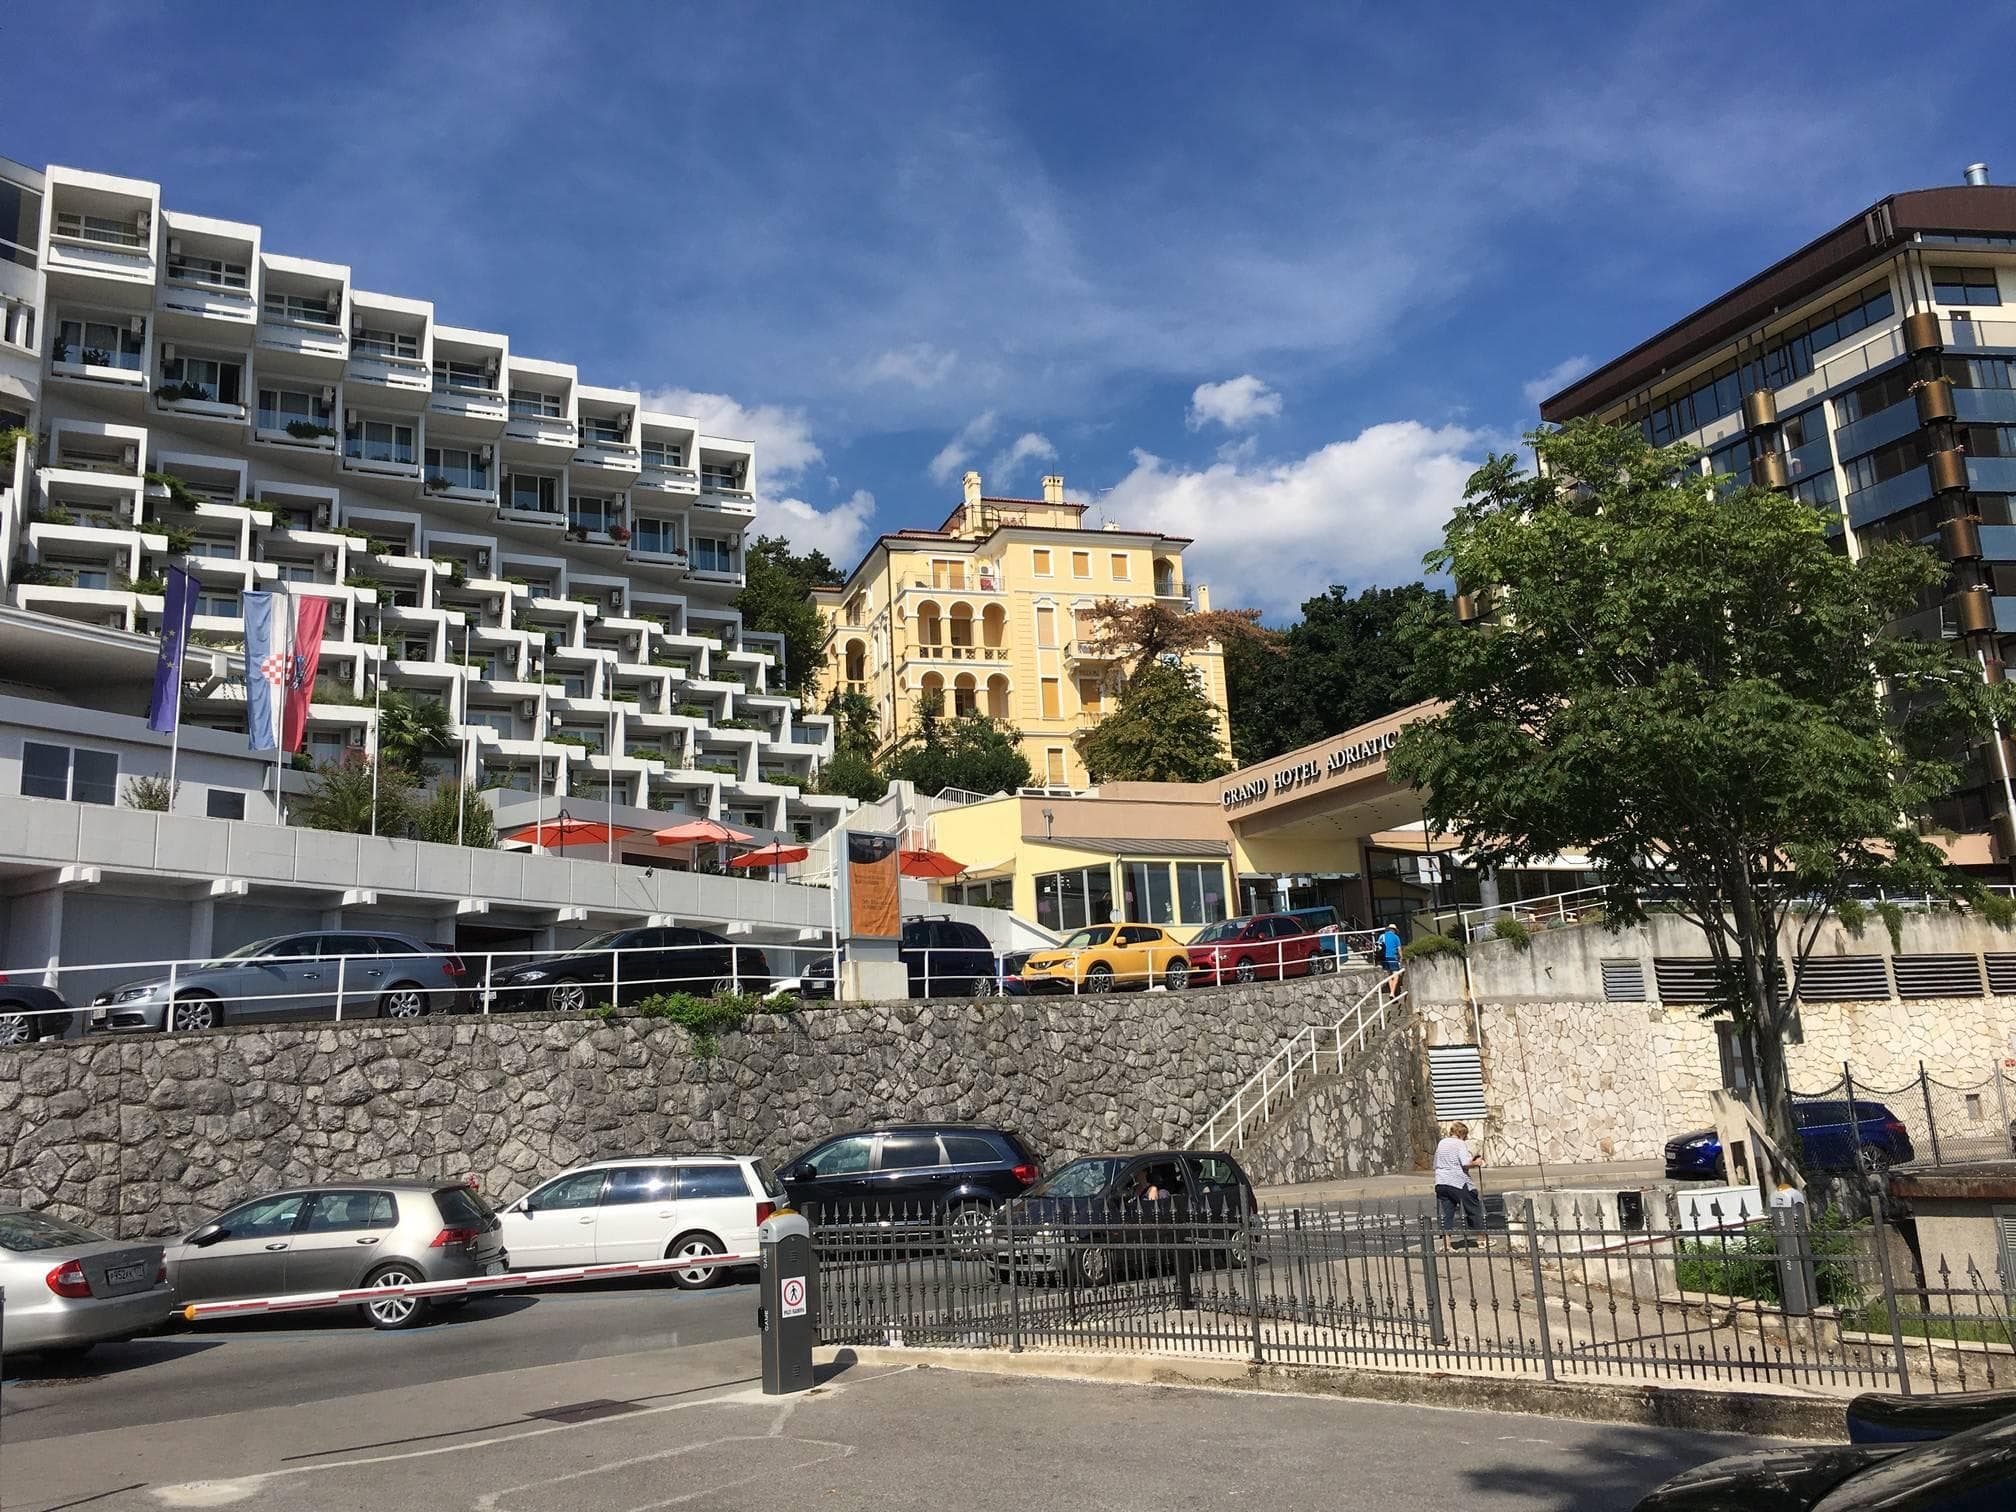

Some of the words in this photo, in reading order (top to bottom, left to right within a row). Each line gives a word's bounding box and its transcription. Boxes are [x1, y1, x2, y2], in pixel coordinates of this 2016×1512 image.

[1222, 778, 1267, 805] GRAND
[1272, 760, 1320, 789] HOTEL
[1327, 731, 1398, 771] ADRIATIC
